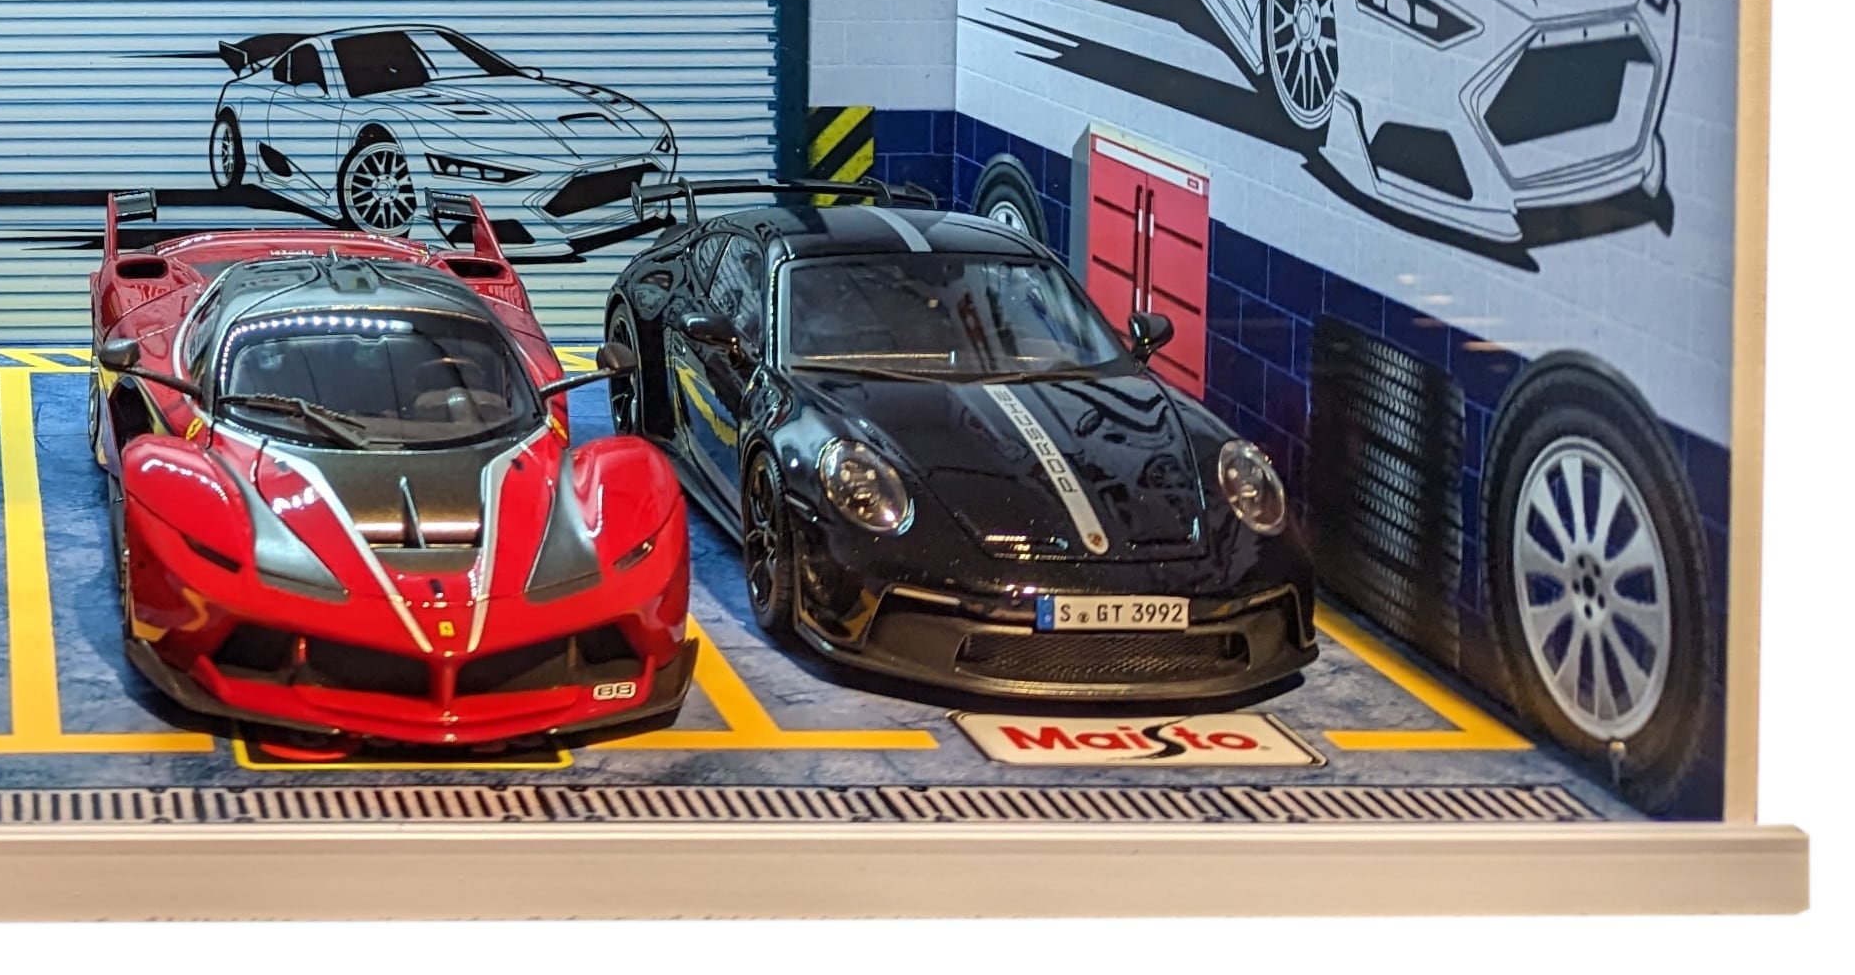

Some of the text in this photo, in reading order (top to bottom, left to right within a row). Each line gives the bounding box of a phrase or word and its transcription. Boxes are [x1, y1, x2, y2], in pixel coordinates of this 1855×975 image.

[993, 390, 1078, 494] PORSCHE
[1059, 603, 1183, 623] S GT 3992
